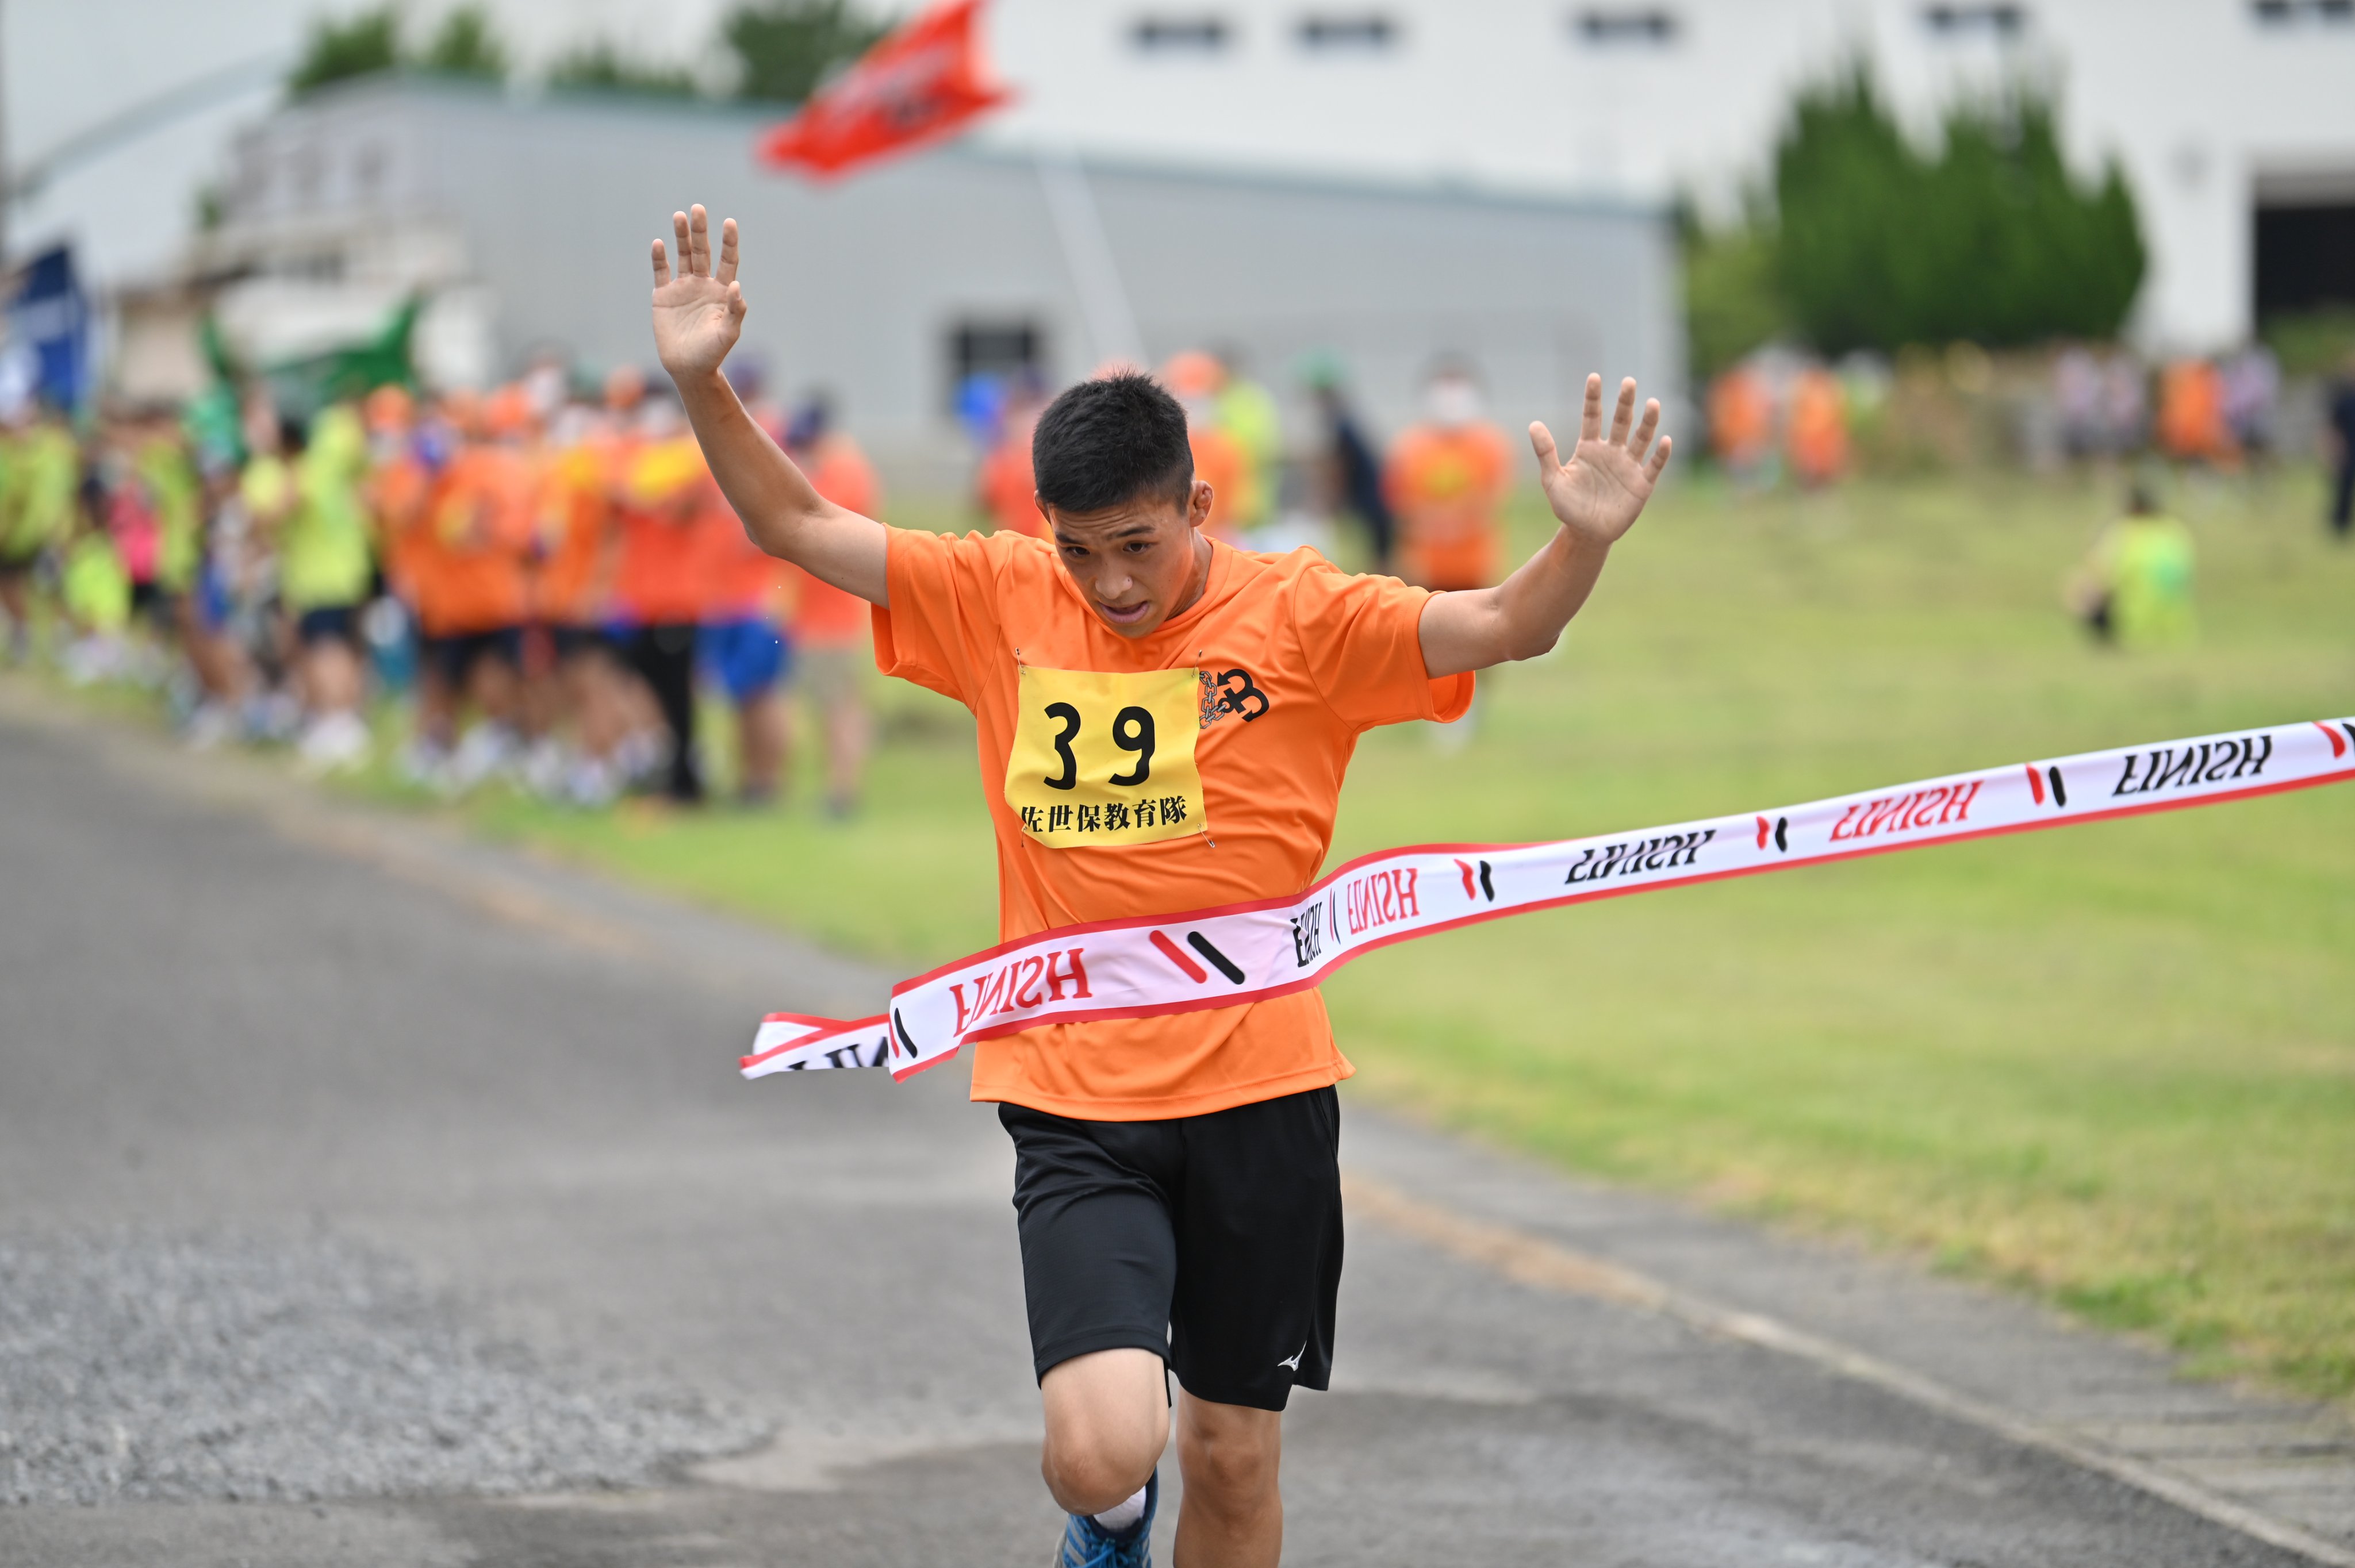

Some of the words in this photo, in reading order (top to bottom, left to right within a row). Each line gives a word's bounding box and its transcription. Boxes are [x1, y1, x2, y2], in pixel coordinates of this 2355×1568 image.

[1044, 702, 1156, 790] 39
[1021, 795, 1187, 832] 佐世保教育隊
